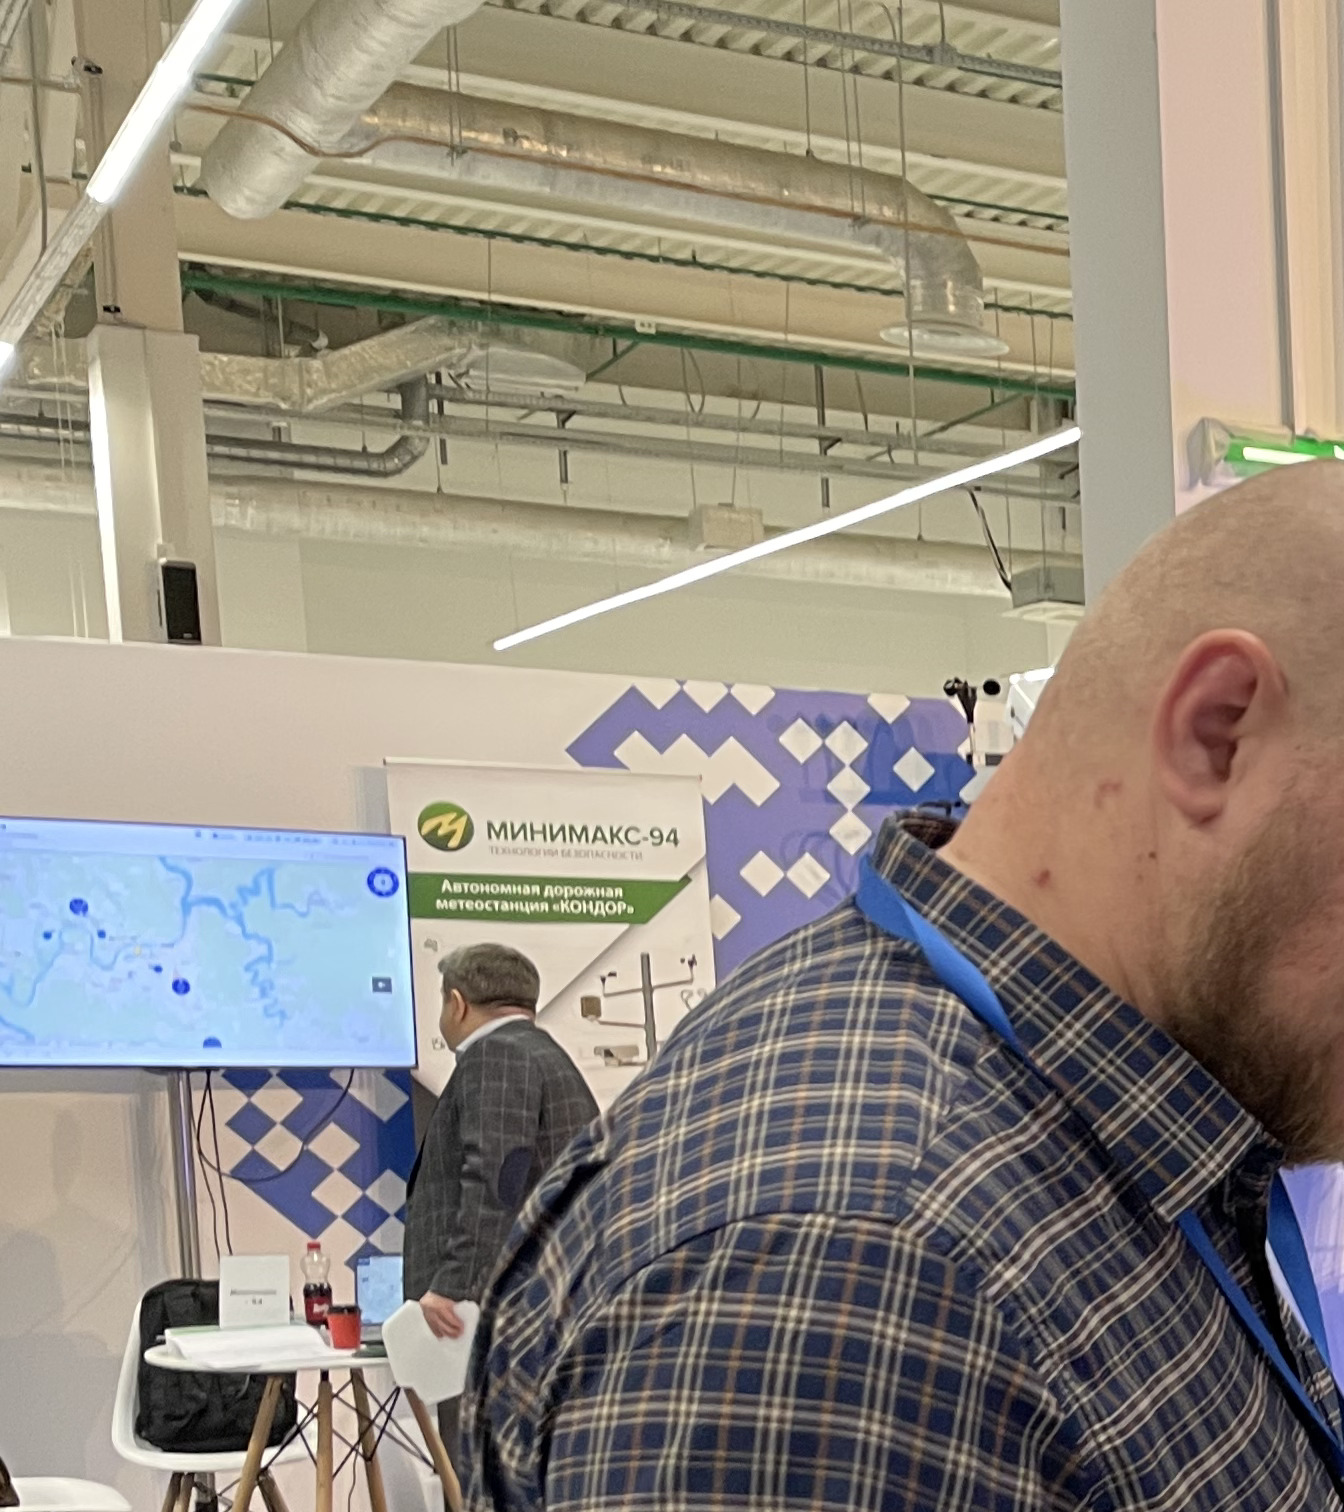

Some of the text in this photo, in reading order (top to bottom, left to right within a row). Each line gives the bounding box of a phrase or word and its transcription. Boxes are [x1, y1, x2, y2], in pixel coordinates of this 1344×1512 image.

[486, 820, 680, 848] МИНИМАКС-94
[441, 879, 623, 899] Автономная дорожная
[435, 898, 635, 917] метеостанция «КОНДОР»
